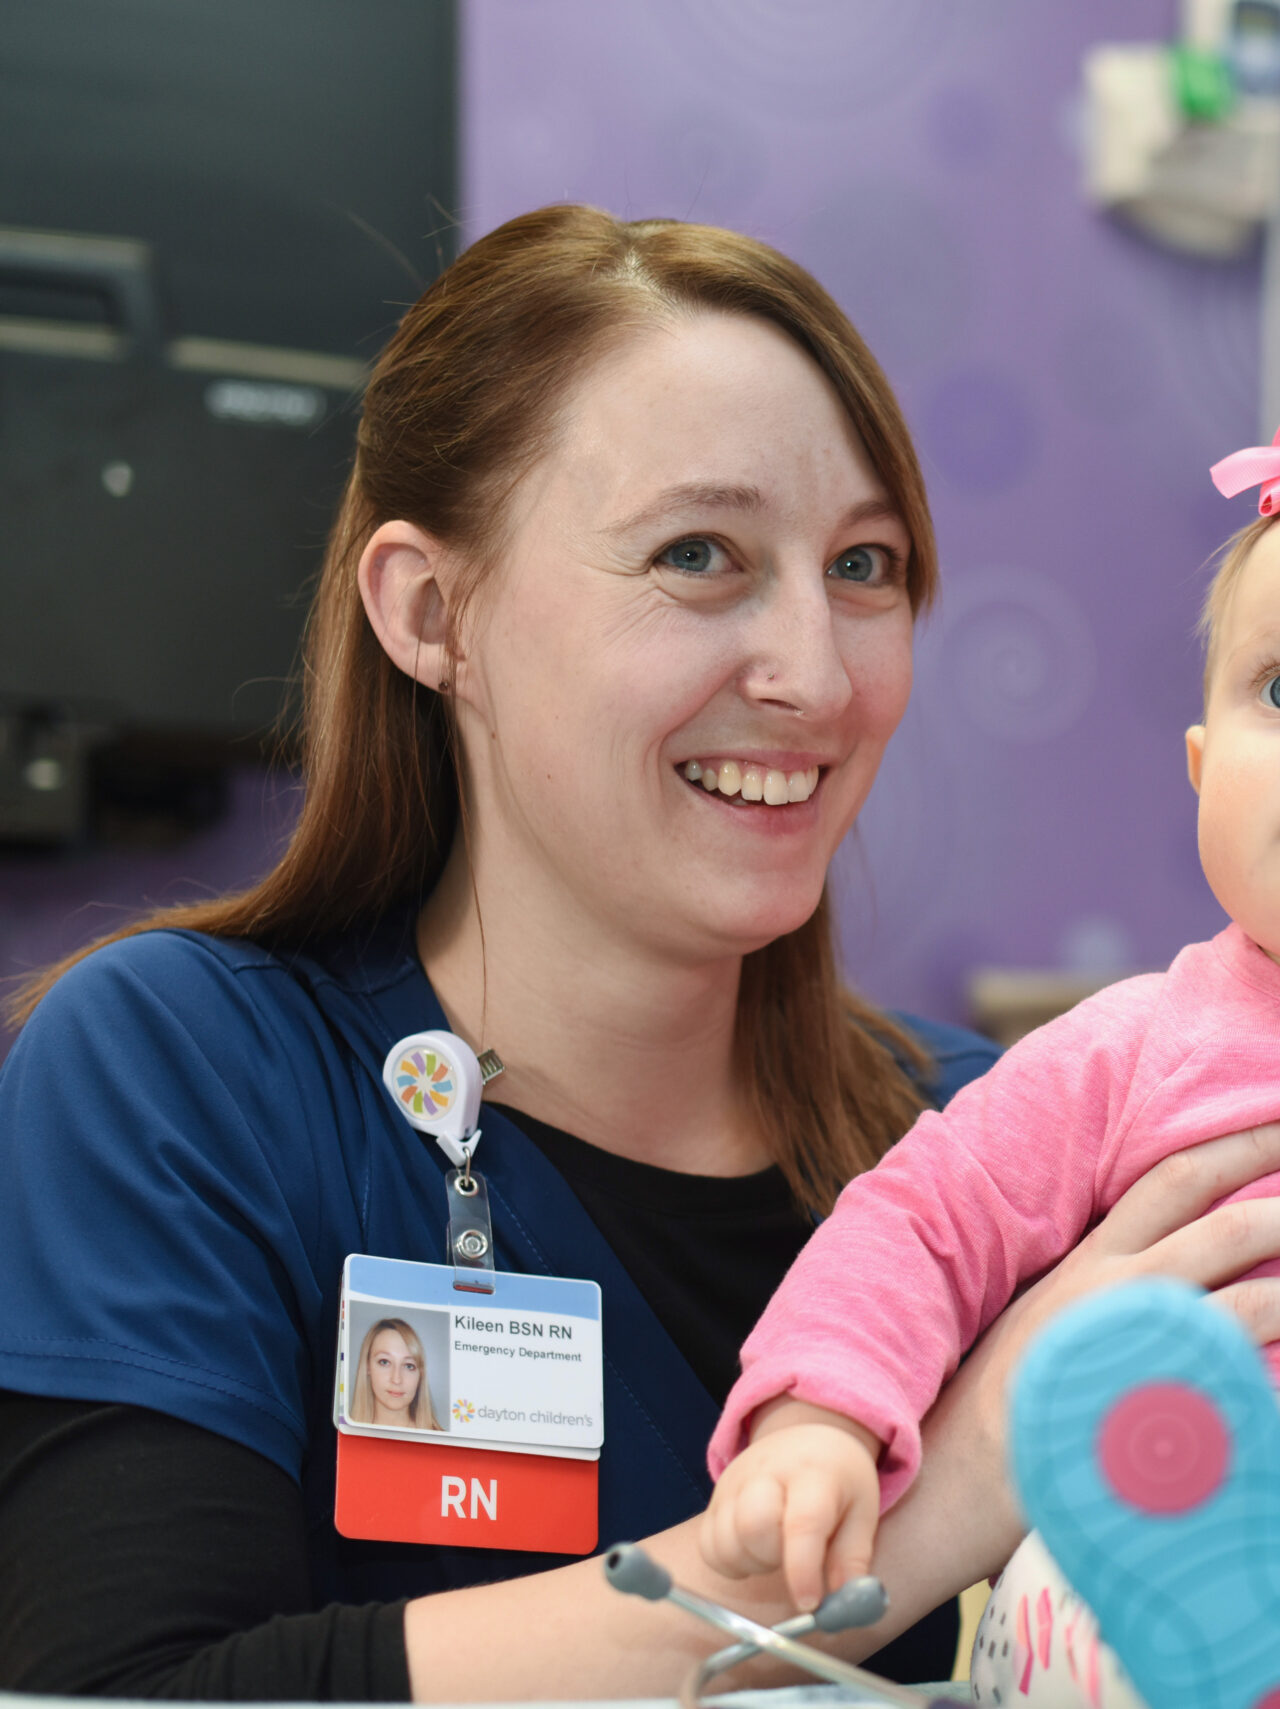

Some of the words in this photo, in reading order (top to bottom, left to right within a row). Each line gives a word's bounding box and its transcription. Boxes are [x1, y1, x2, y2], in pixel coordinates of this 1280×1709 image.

[455, 1315, 504, 1334] Kileen
[509, 1322, 543, 1338] BSN
[549, 1325, 572, 1340] RN
[454, 1340, 516, 1358] Emergency
[519, 1349, 582, 1362] Department
[478, 1405, 526, 1422] dayton
[529, 1409, 593, 1427] children's
[440, 1475, 498, 1521] RN
